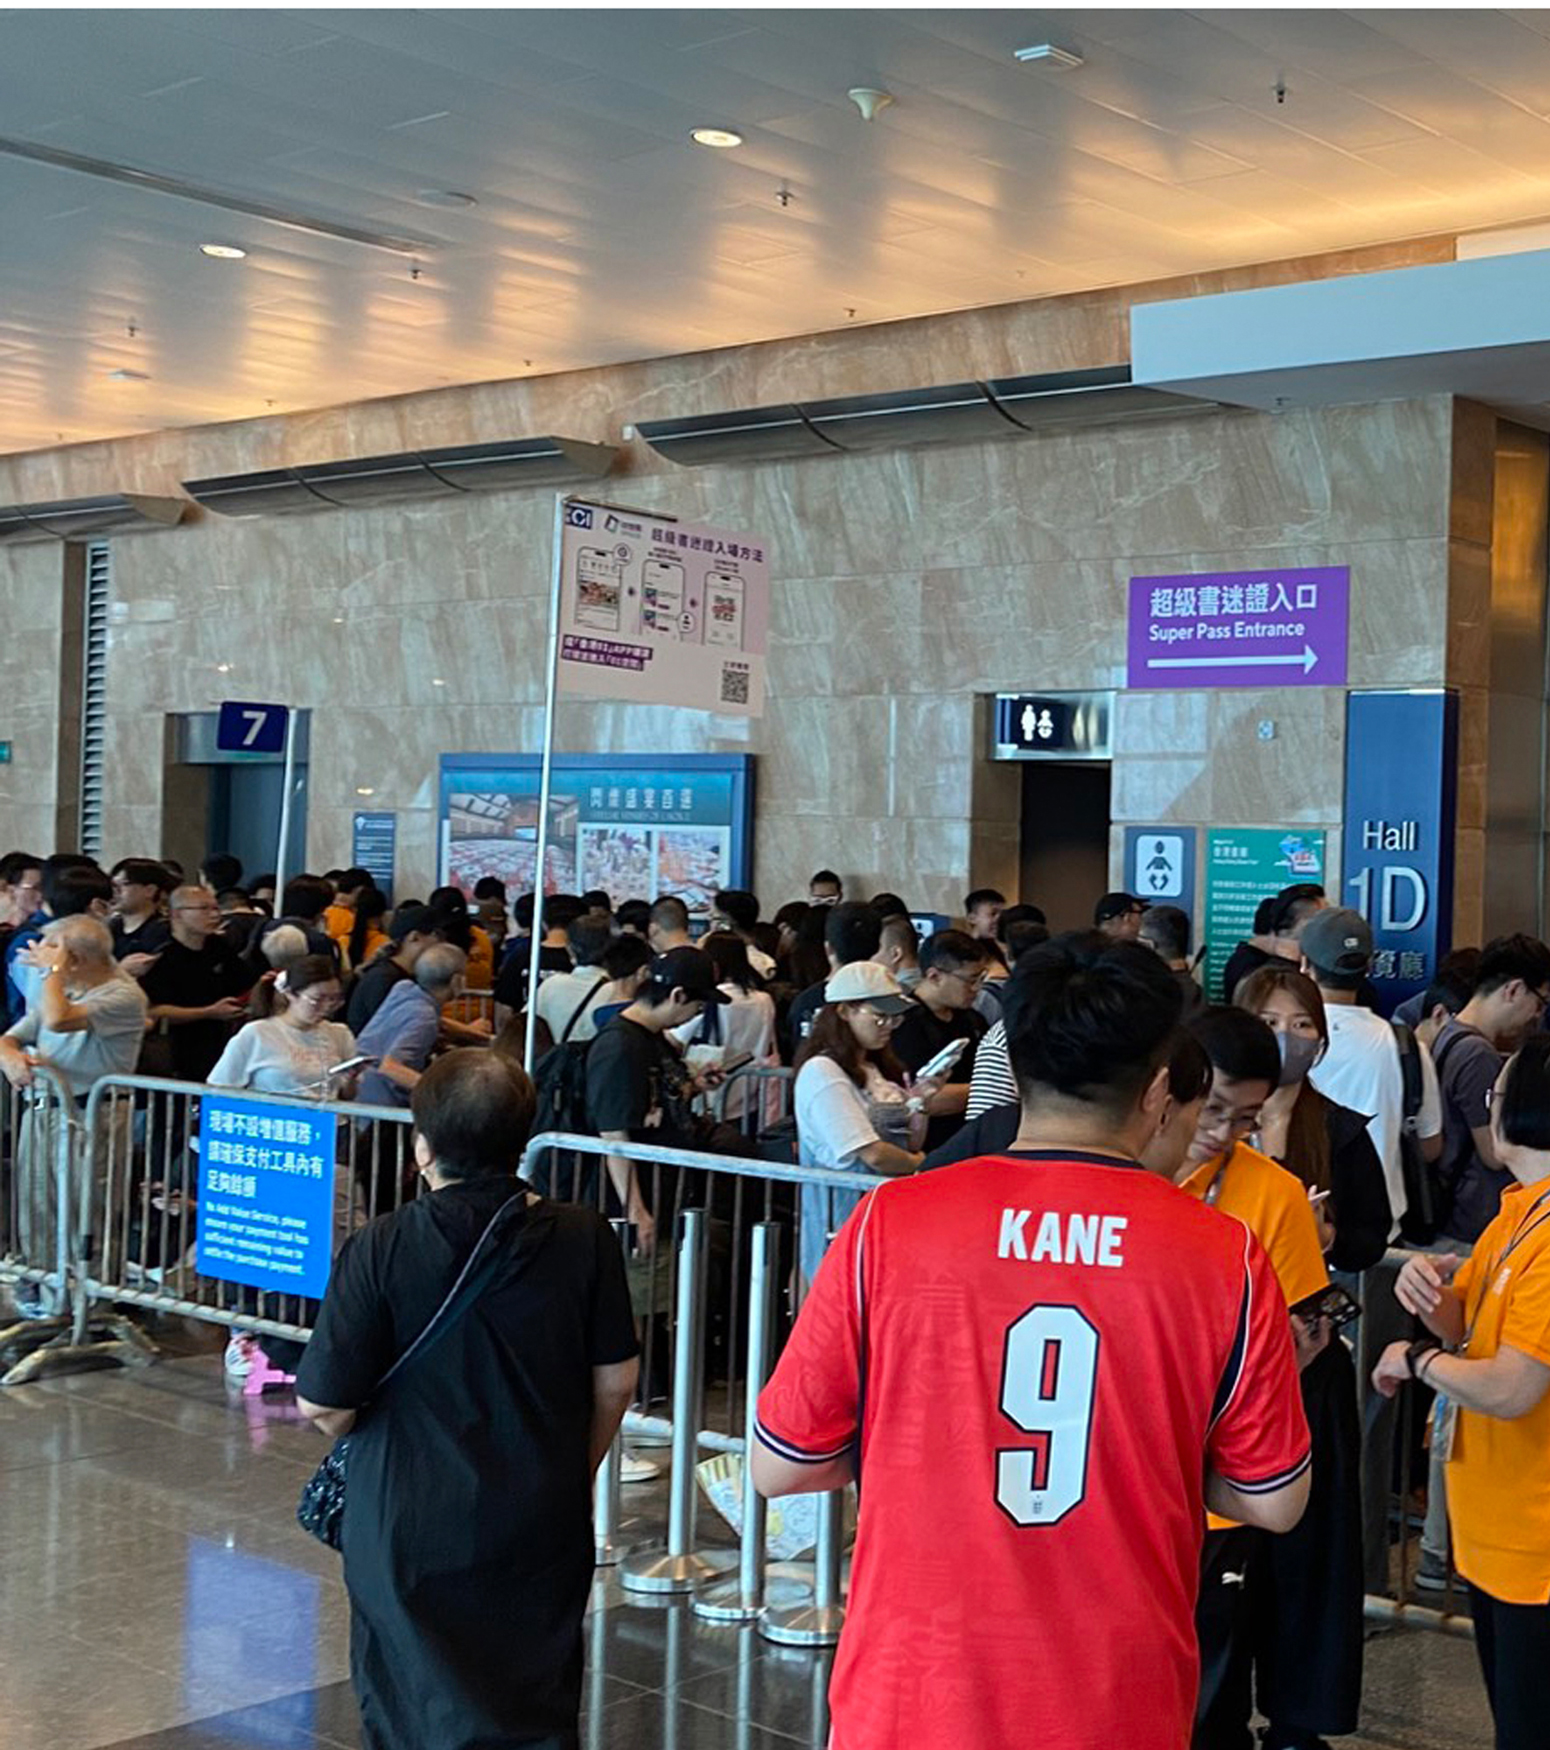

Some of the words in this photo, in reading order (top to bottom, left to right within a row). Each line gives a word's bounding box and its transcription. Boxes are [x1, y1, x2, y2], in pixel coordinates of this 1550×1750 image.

[1150, 582, 1318, 618] 超級書迷證入口
[1149, 623, 1194, 645] Super
[1196, 623, 1231, 640] Pass
[1234, 620, 1305, 639] Entrance
[241, 710, 268, 746] 7
[1362, 820, 1415, 852] Hall
[1348, 866, 1427, 932] 1D
[1364, 949, 1425, 980] 覽廳
[998, 1208, 1128, 1268] KANE
[994, 1302, 1101, 1528] 9
